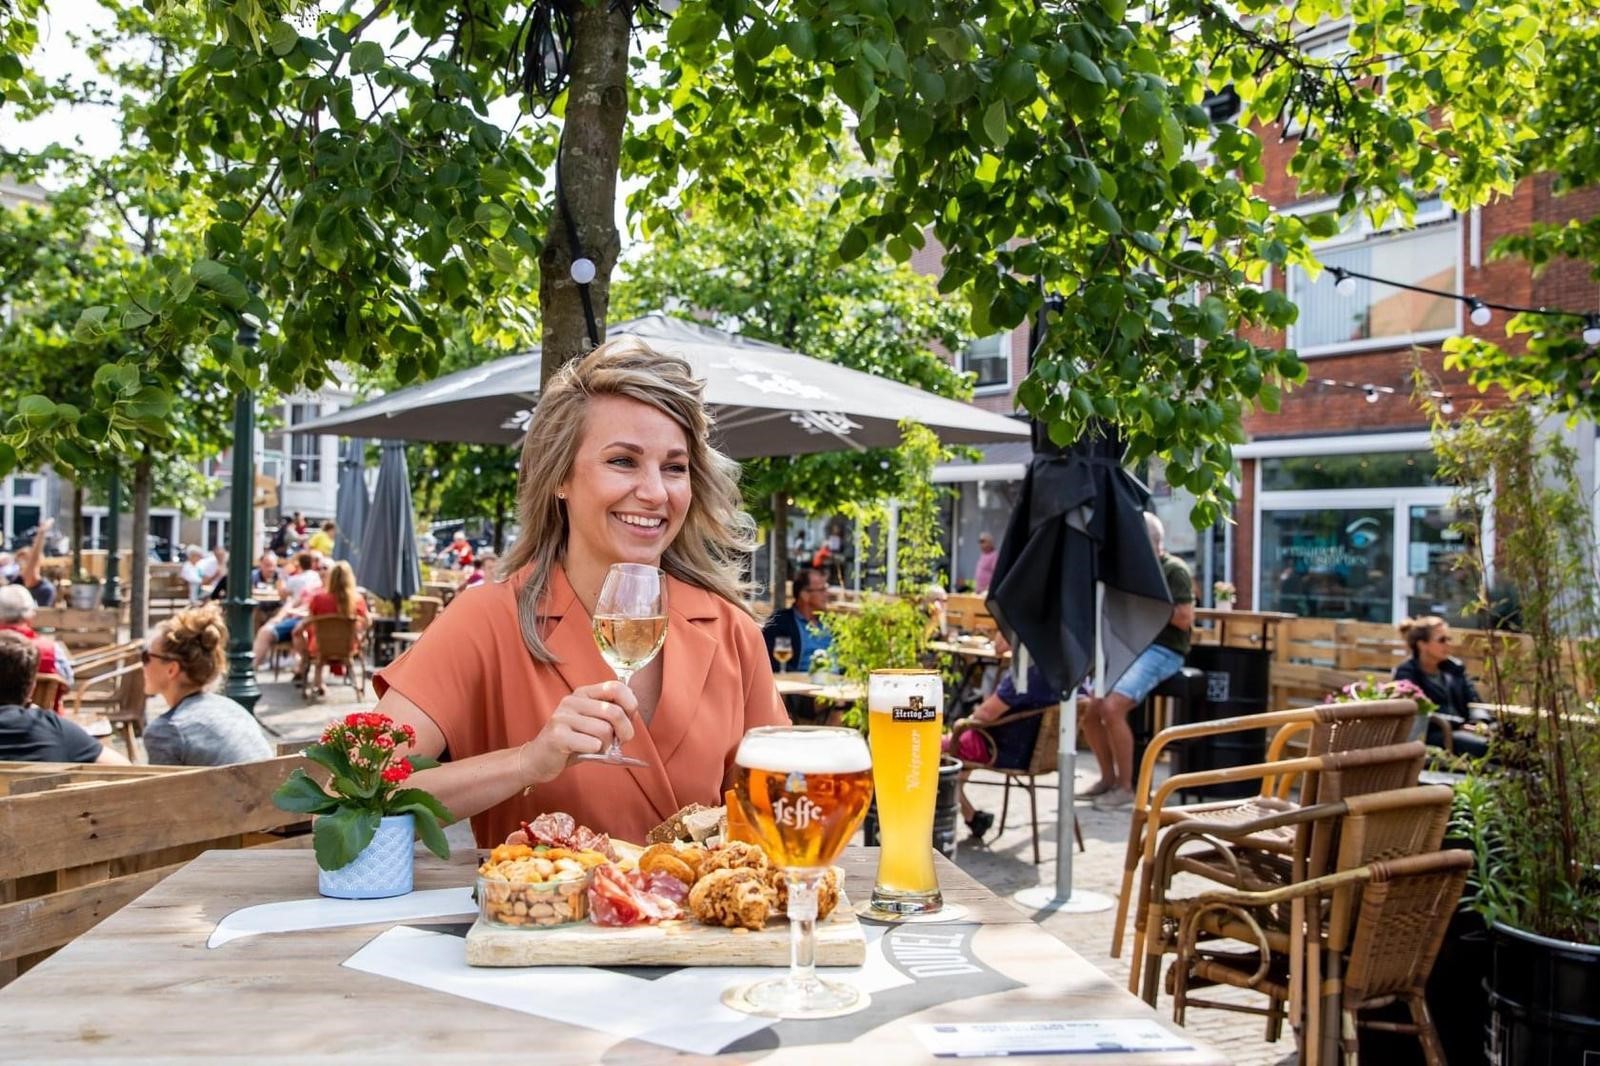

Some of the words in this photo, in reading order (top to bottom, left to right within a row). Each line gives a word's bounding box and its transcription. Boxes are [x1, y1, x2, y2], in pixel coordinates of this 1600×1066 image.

[895, 709, 922, 719] Hertog
[772, 795, 822, 830] Leffe
[891, 932, 983, 978] DUVEL
